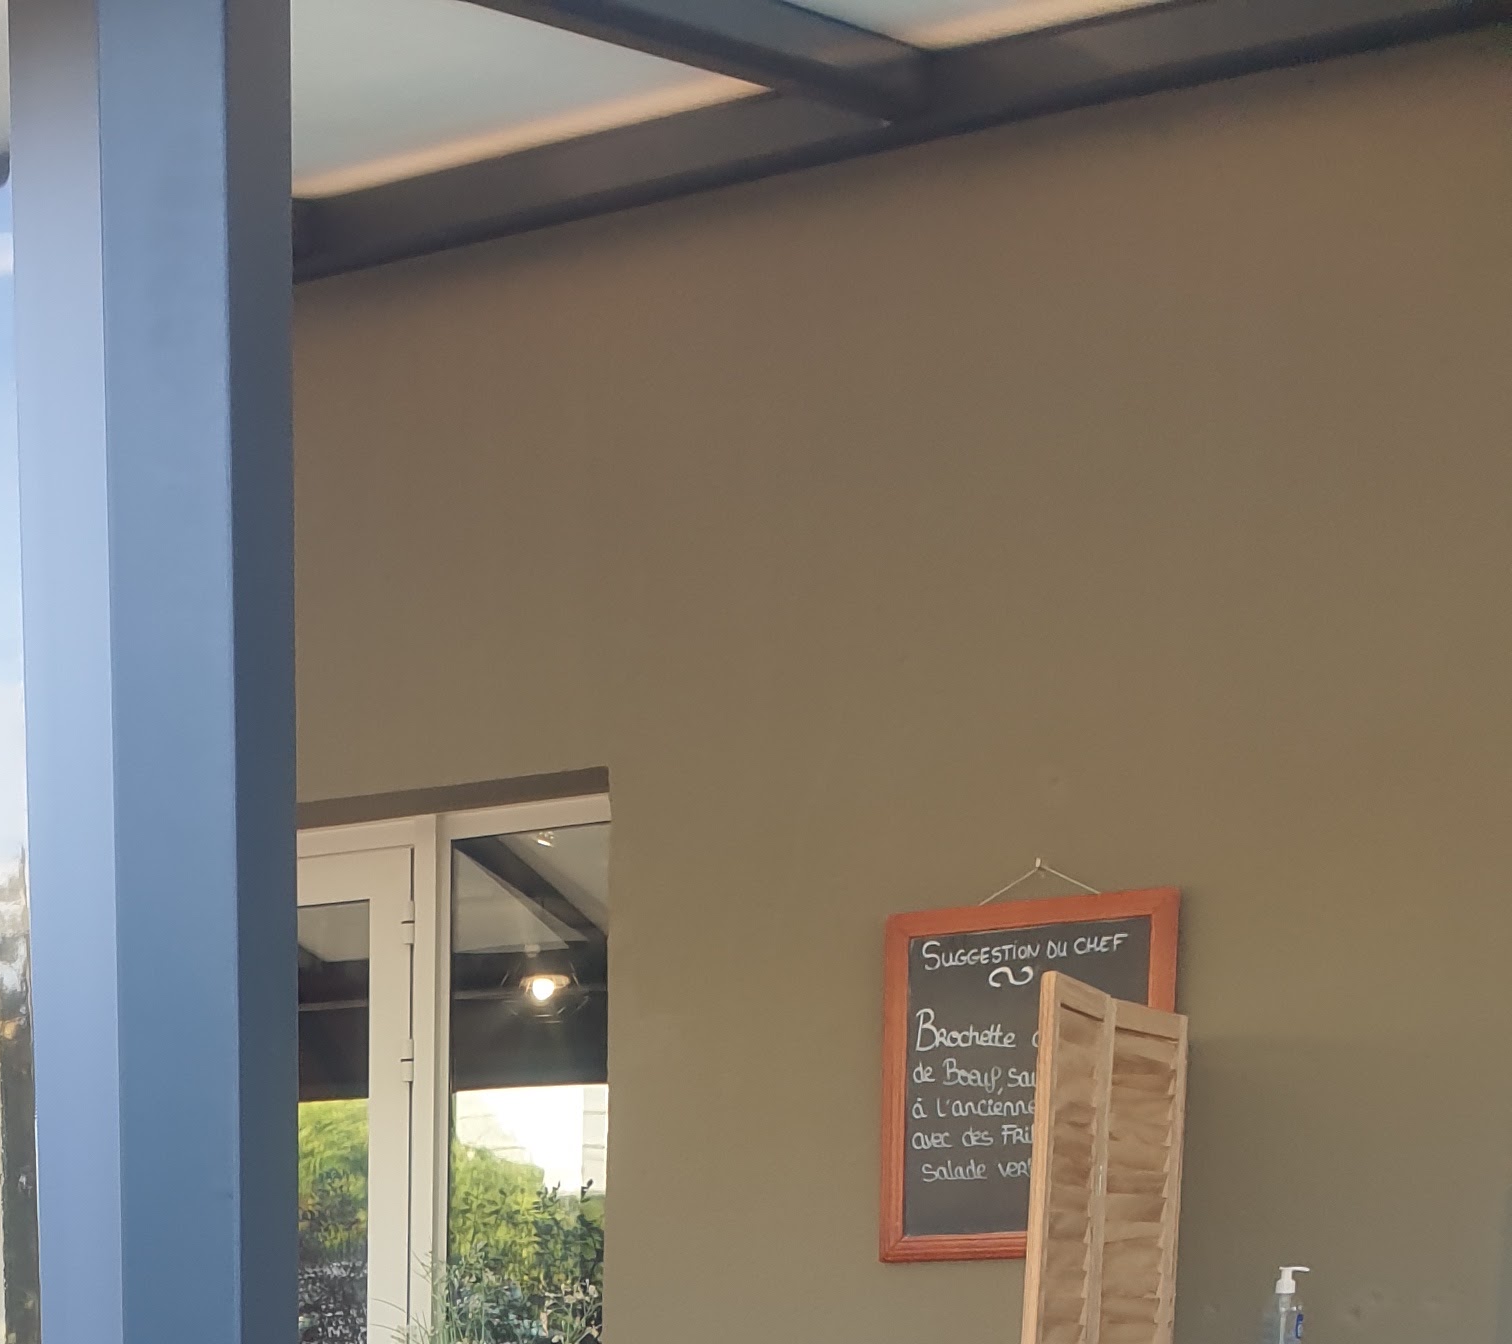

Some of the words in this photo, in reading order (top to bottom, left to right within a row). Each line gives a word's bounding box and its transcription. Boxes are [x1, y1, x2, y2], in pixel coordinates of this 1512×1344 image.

[922, 940, 1040, 971] SUGGESTION
[1046, 940, 1068, 959] DU
[1073, 933, 1129, 955] CHEF
[912, 1061, 936, 1083] de
[911, 1131, 953, 1150] avec
[961, 1126, 994, 1148] des
